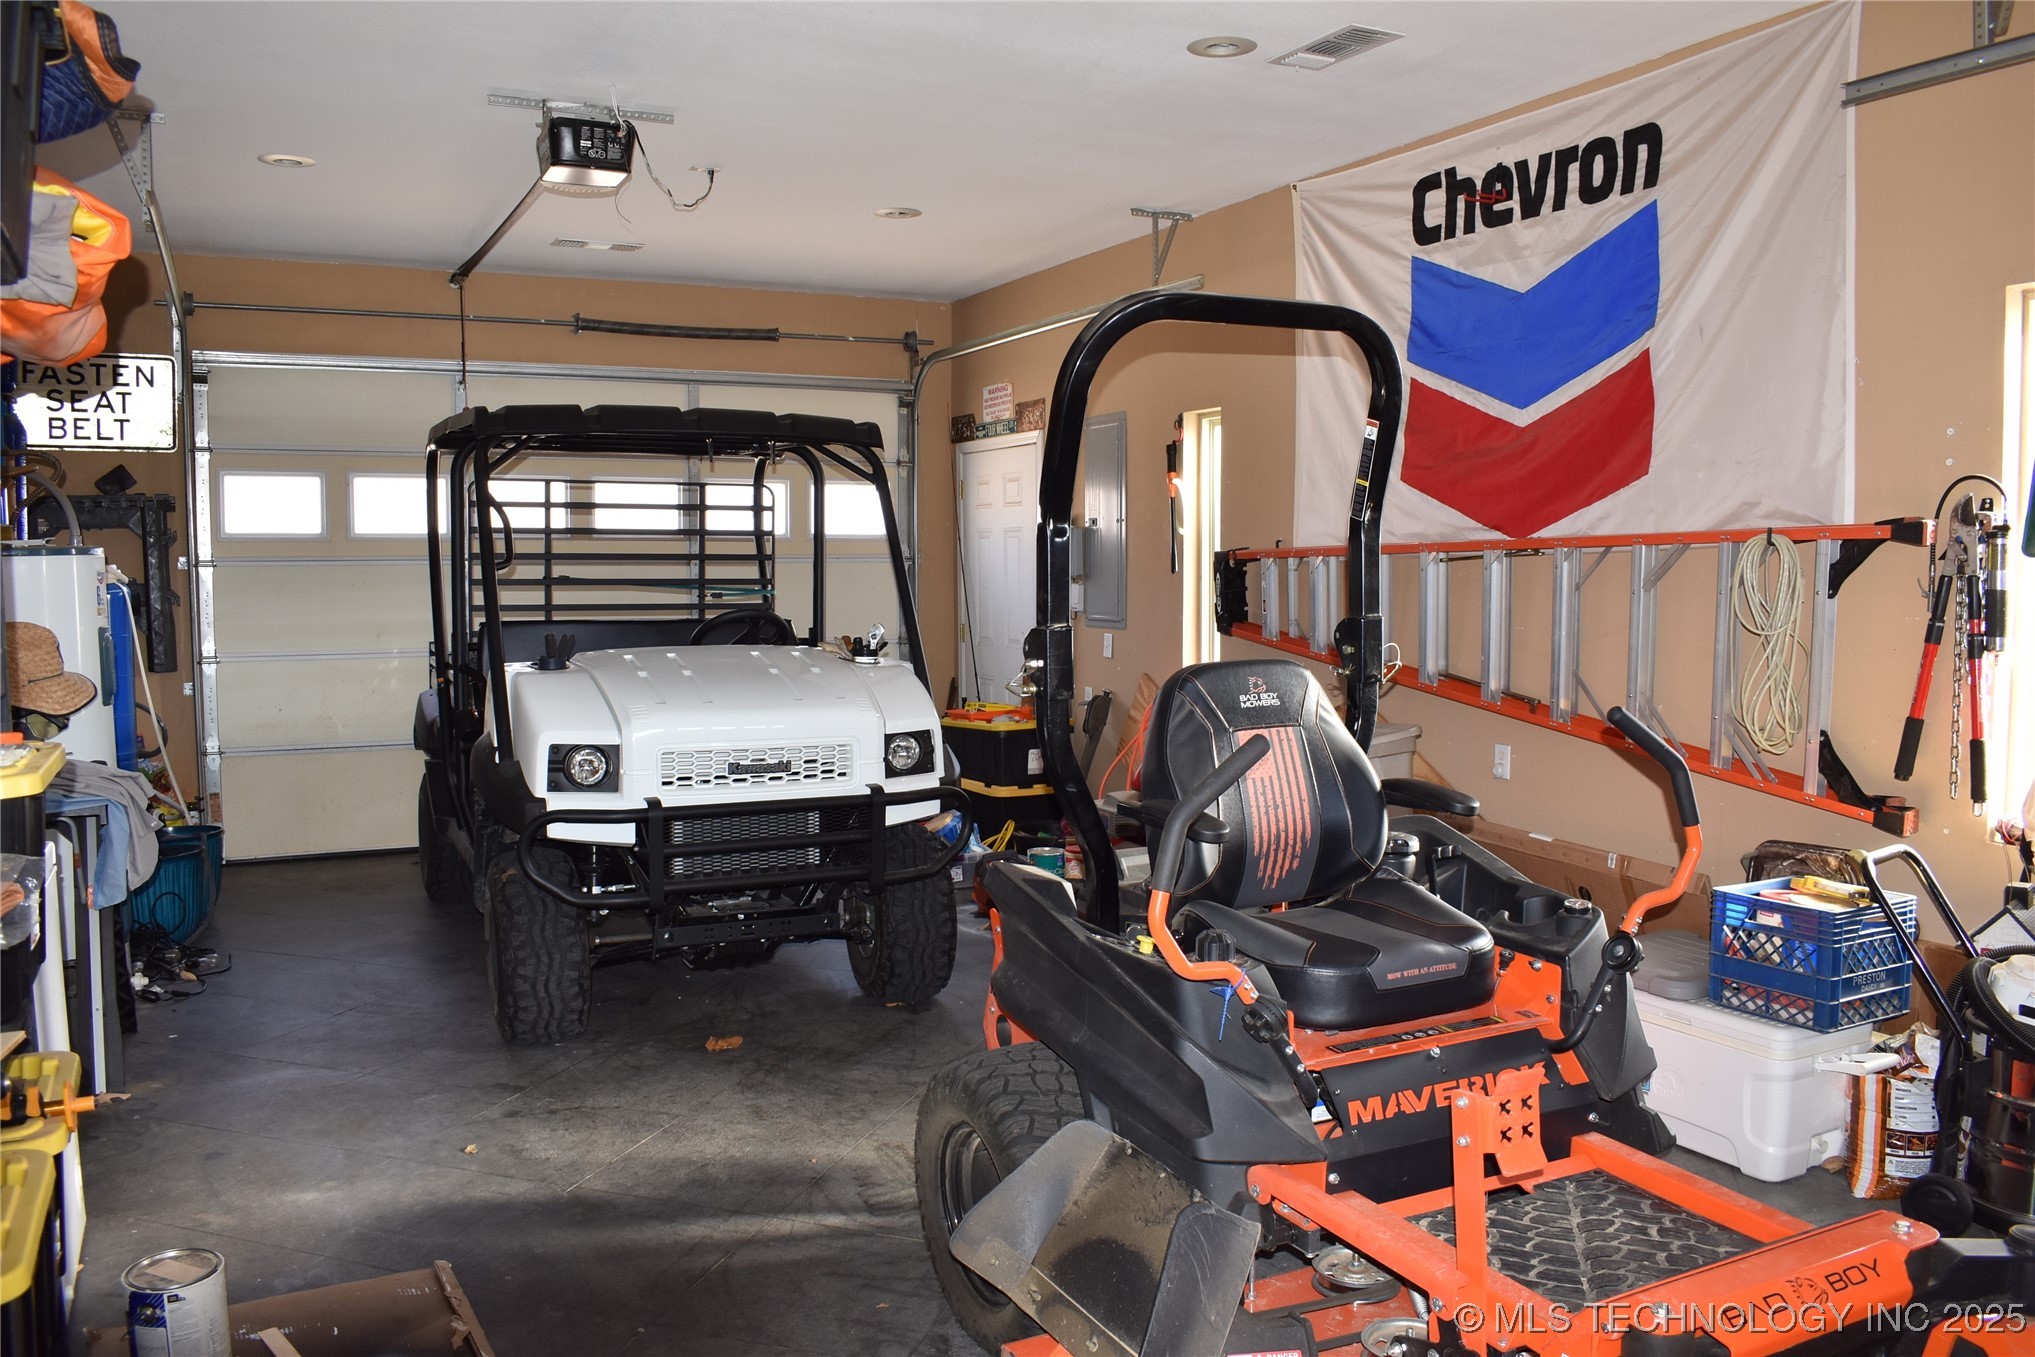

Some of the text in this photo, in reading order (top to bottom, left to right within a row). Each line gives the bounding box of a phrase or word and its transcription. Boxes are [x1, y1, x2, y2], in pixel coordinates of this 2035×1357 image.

[1412, 122, 1663, 246] Chevron
[22, 361, 154, 387] FASTEN
[988, 384, 1008, 395] WARNING
[46, 389, 132, 414] SEAT
[48, 417, 131, 441] BELT
[1241, 699, 1280, 708] MOWERS
[728, 760, 791, 775] Kawasaki
[1387, 972, 1401, 980] MOW
[1403, 969, 1419, 977] WITH
[1429, 963, 1457, 972] ATTITUDE
[1853, 971, 1886, 986] PRESTON
[1824, 1258, 1881, 1292] BOY
